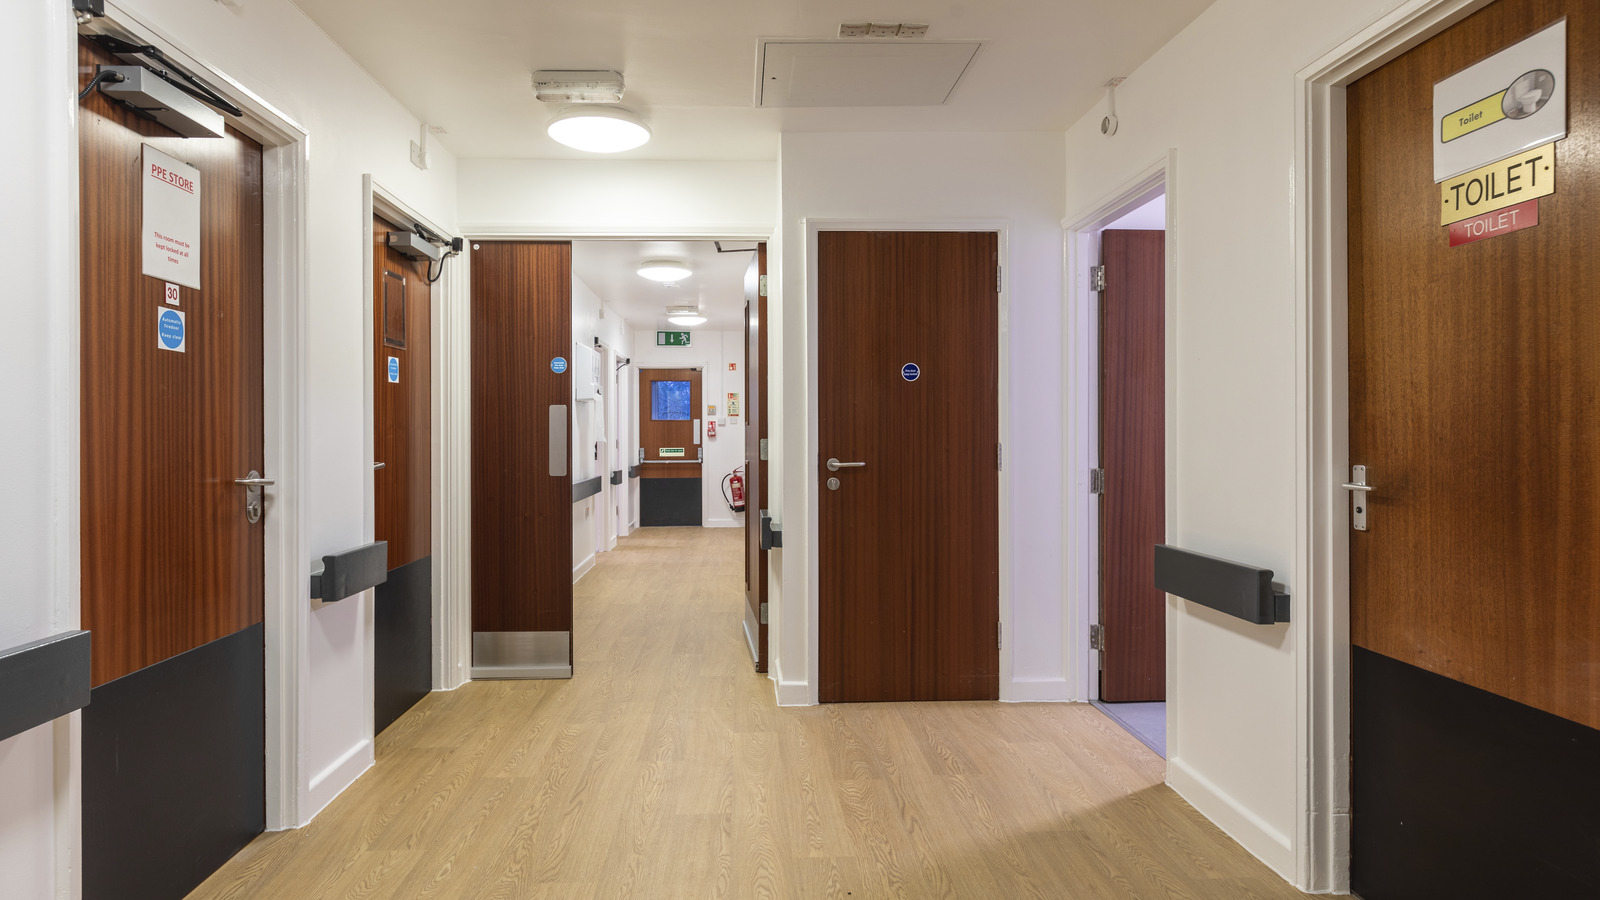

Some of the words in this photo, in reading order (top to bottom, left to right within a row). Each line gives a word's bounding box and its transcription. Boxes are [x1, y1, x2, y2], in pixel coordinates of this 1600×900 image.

[1458, 110, 1484, 127] Toilet
[151, 163, 167, 180] PPE
[169, 171, 194, 192] STORE
[1450, 155, 1543, 211] TOILET
[1464, 209, 1520, 238] TOILET
[154, 231, 163, 240] This
[163, 235, 175, 243] room
[174, 239, 185, 247] must
[155, 242, 166, 251] kept
[165, 245, 179, 255] locked
[167, 256, 179, 264] times
[167, 287, 178, 301] 30
[162, 316, 182, 325] Automatic
